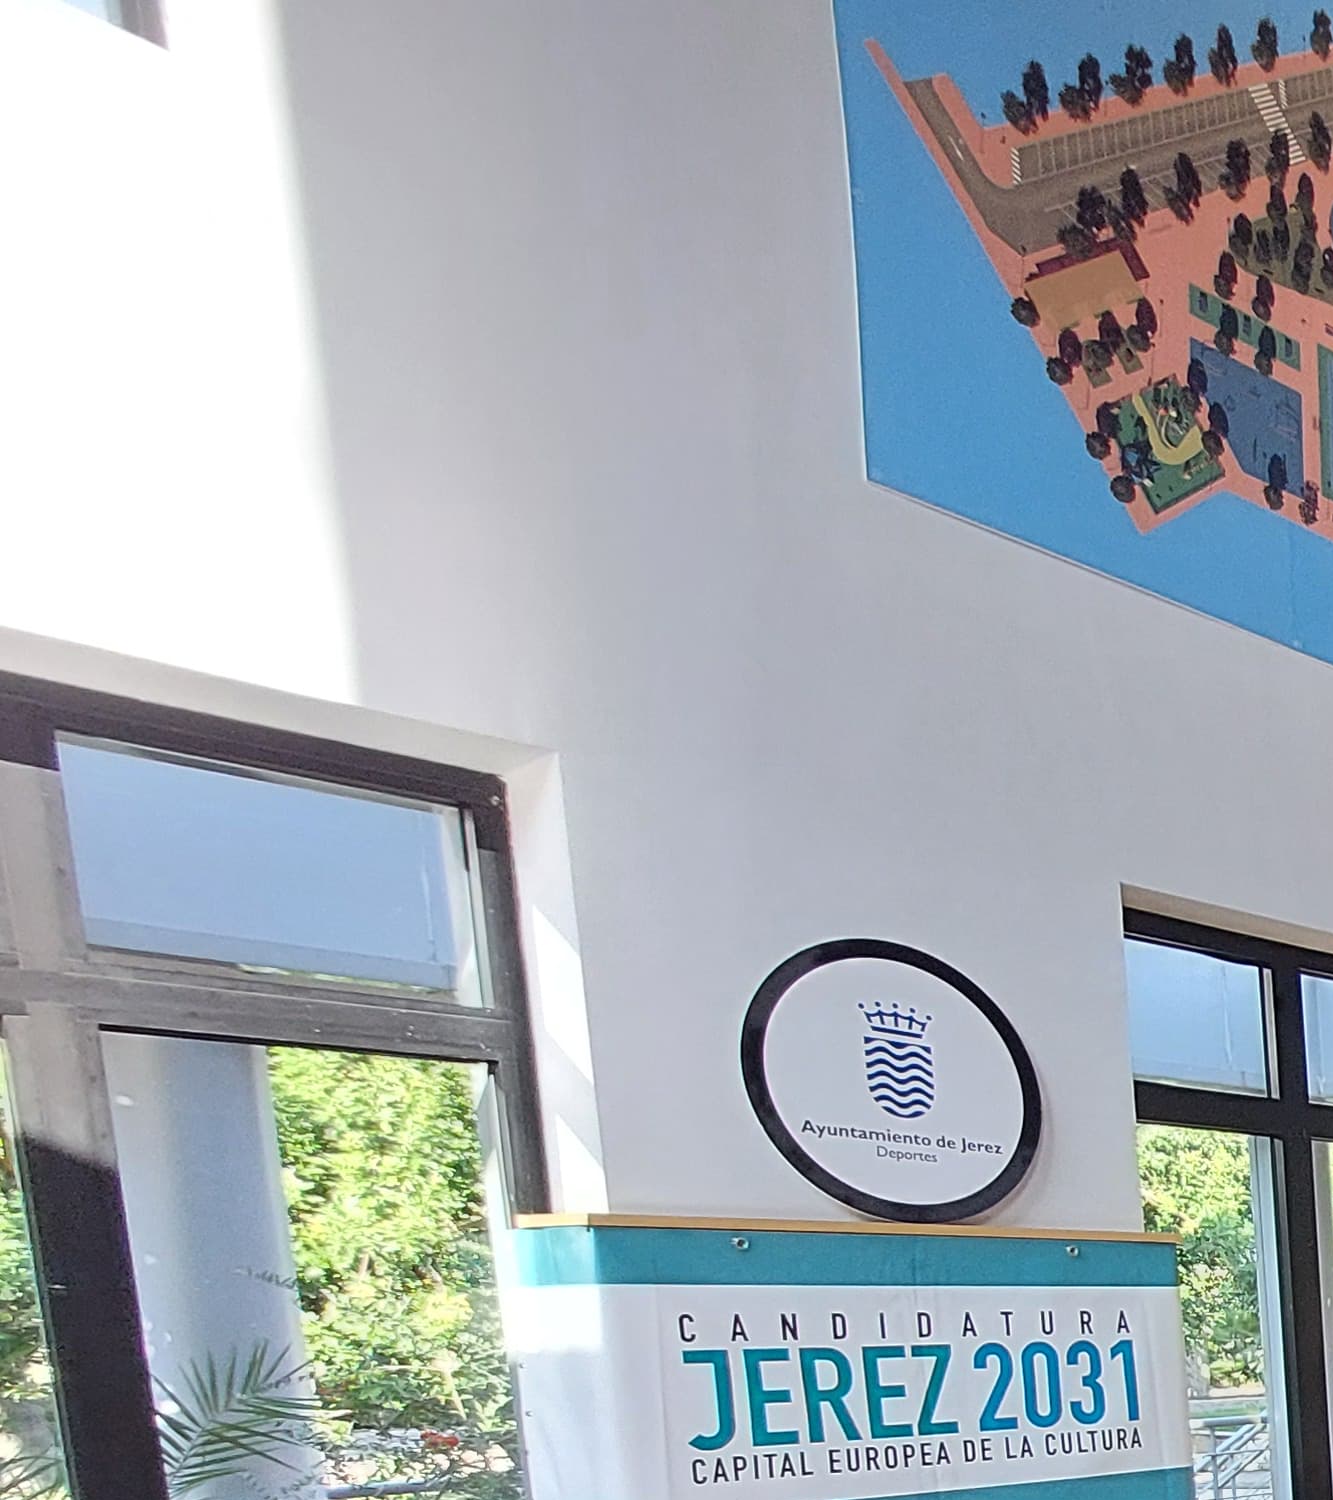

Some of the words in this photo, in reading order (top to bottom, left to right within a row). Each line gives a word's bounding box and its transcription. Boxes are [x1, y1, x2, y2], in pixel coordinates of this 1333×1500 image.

[800, 1118, 932, 1150] Ayuntamiento
[936, 1132, 957, 1150] de
[961, 1135, 1003, 1157] Jerez
[876, 1144, 938, 1165] Deportes
[678, 1310, 1131, 1344] CANDIDATURA
[681, 1344, 958, 1452] JEREZ
[973, 1338, 1142, 1433] 2031
[691, 1451, 814, 1486] CAPITAL
[829, 1440, 950, 1475] EUROPEA
[962, 1437, 993, 1464] DE
[1005, 1434, 1034, 1460] LA
[1045, 1426, 1143, 1457] CULTURA
